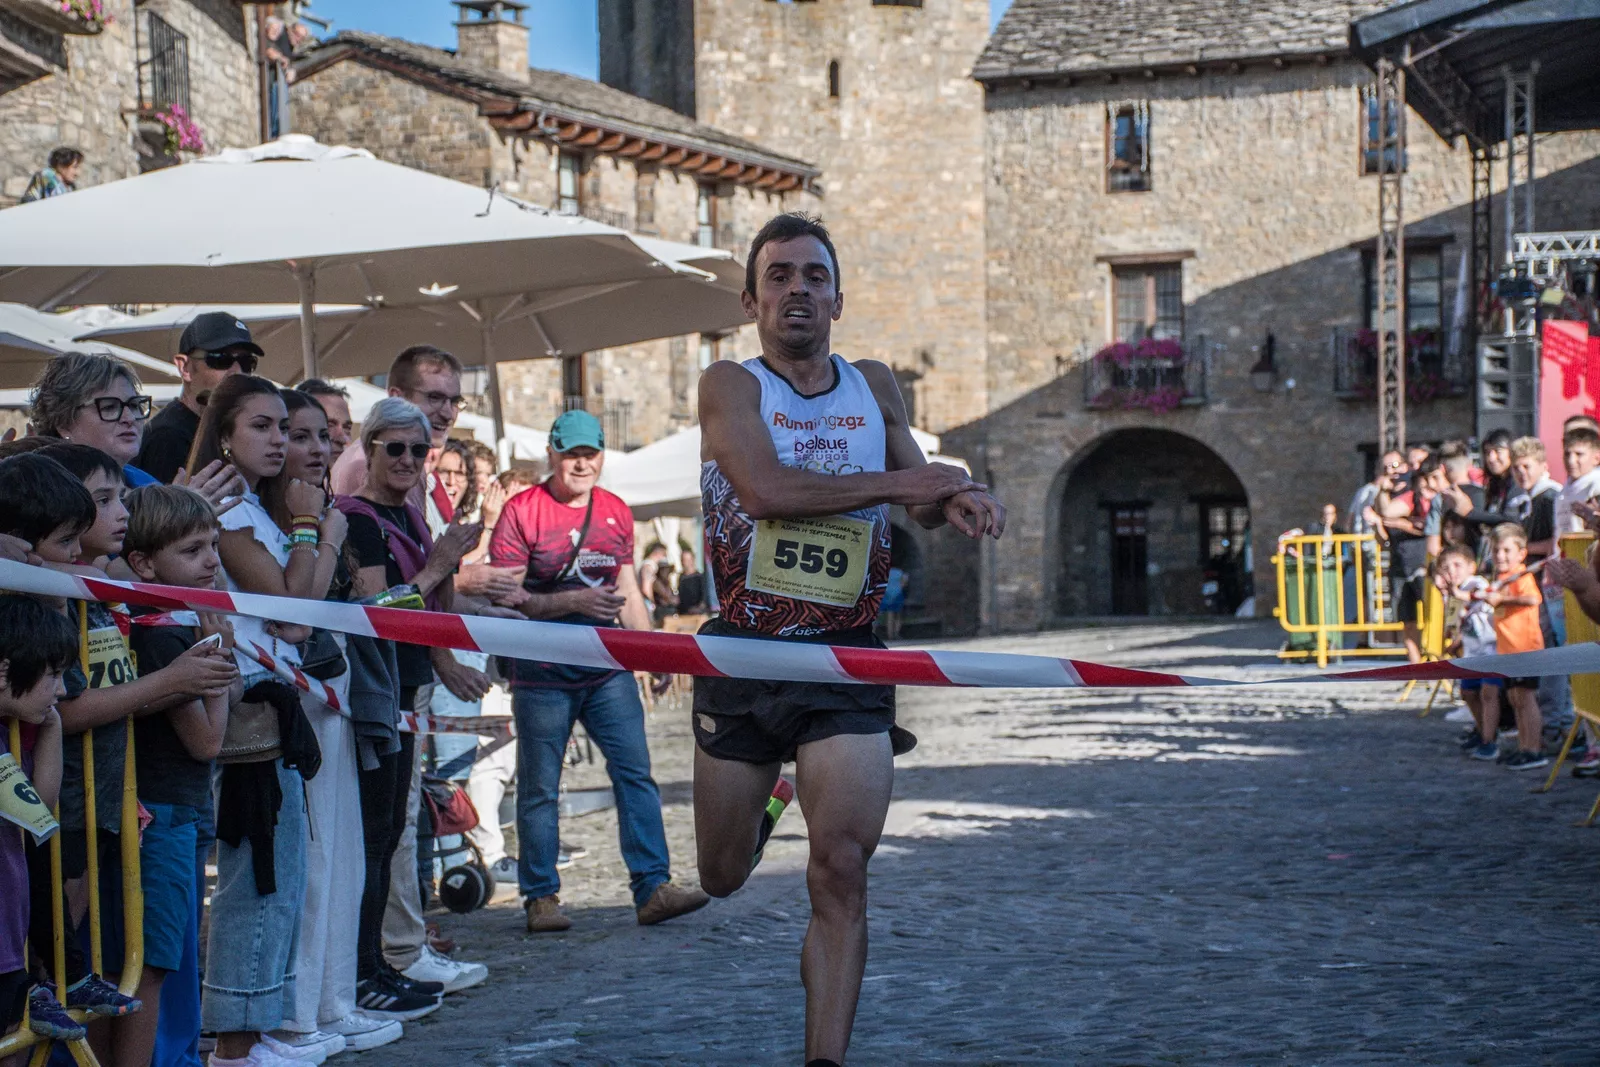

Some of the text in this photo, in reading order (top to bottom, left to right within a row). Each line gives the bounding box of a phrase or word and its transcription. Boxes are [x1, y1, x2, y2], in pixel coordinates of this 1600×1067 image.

[773, 411, 866, 431] Runningzgz
[794, 453, 849, 462] SEGUROS
[773, 538, 849, 578] 559
